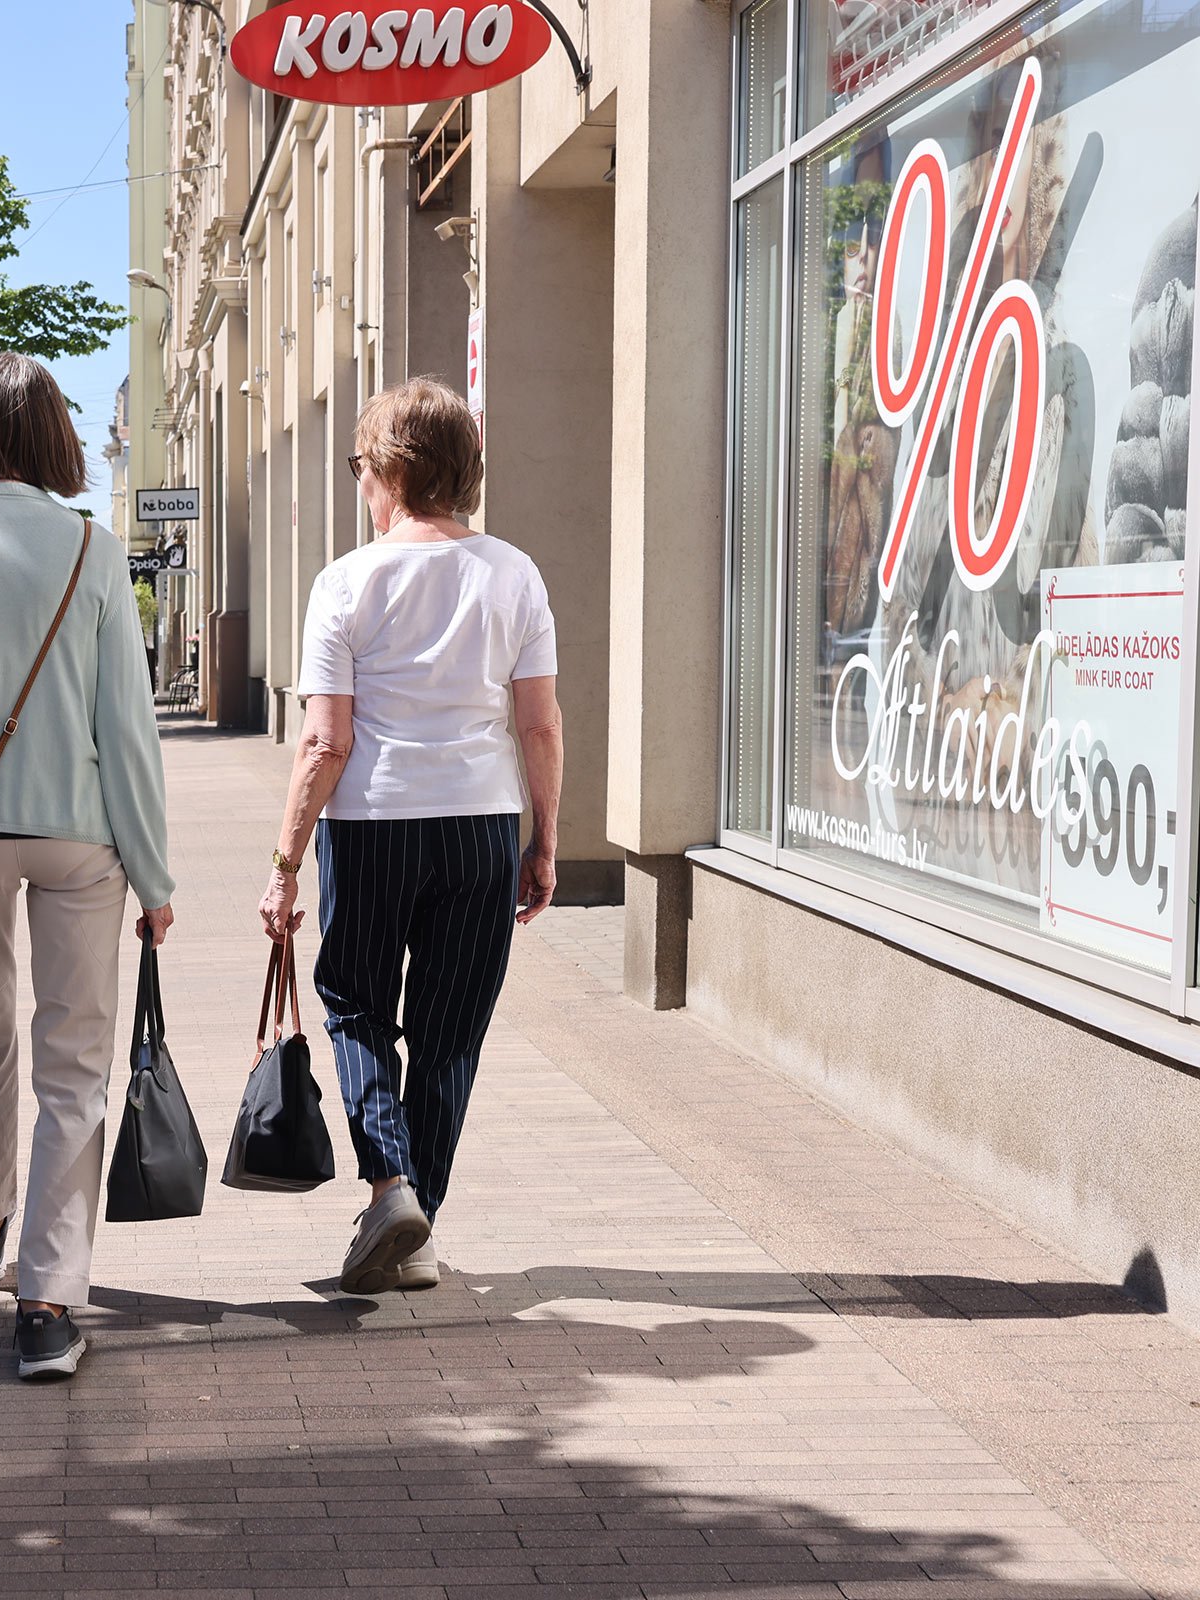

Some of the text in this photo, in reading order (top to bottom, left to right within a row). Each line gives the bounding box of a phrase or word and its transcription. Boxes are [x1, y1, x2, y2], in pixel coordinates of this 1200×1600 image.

[273, 3, 514, 79] KOSMO
[871, 56, 1047, 602] %
[1055, 630, 1181, 662] ŪDEĻĀDAS KAŽOKS
[1075, 668, 1154, 690] MINK FUR COAT
[831, 609, 1092, 826] Atlaides
[786, 804, 928, 872] www.kosmo-furs.lv
